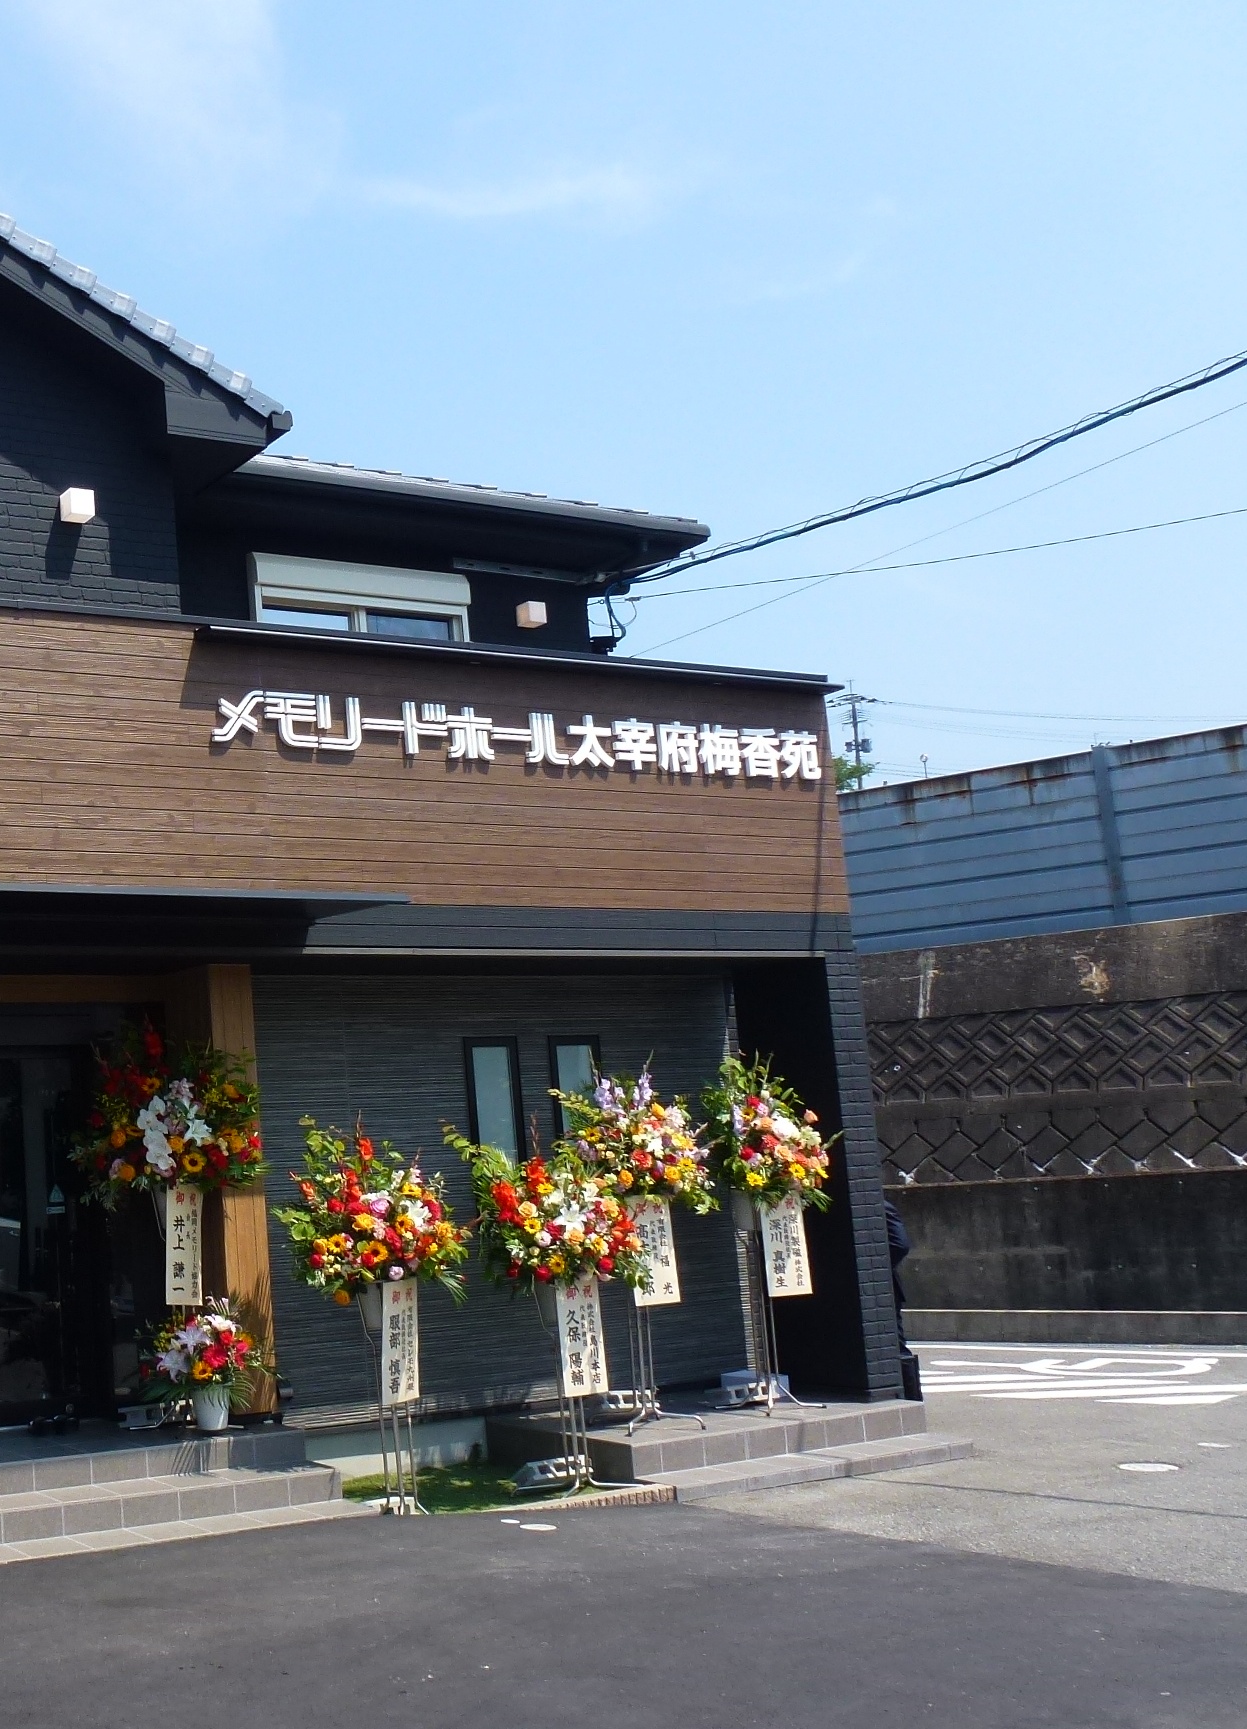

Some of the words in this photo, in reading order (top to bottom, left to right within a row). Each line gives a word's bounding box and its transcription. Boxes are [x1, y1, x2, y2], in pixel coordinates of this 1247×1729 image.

[211, 690, 822, 781] メモリードホール太宰府梅香苑
